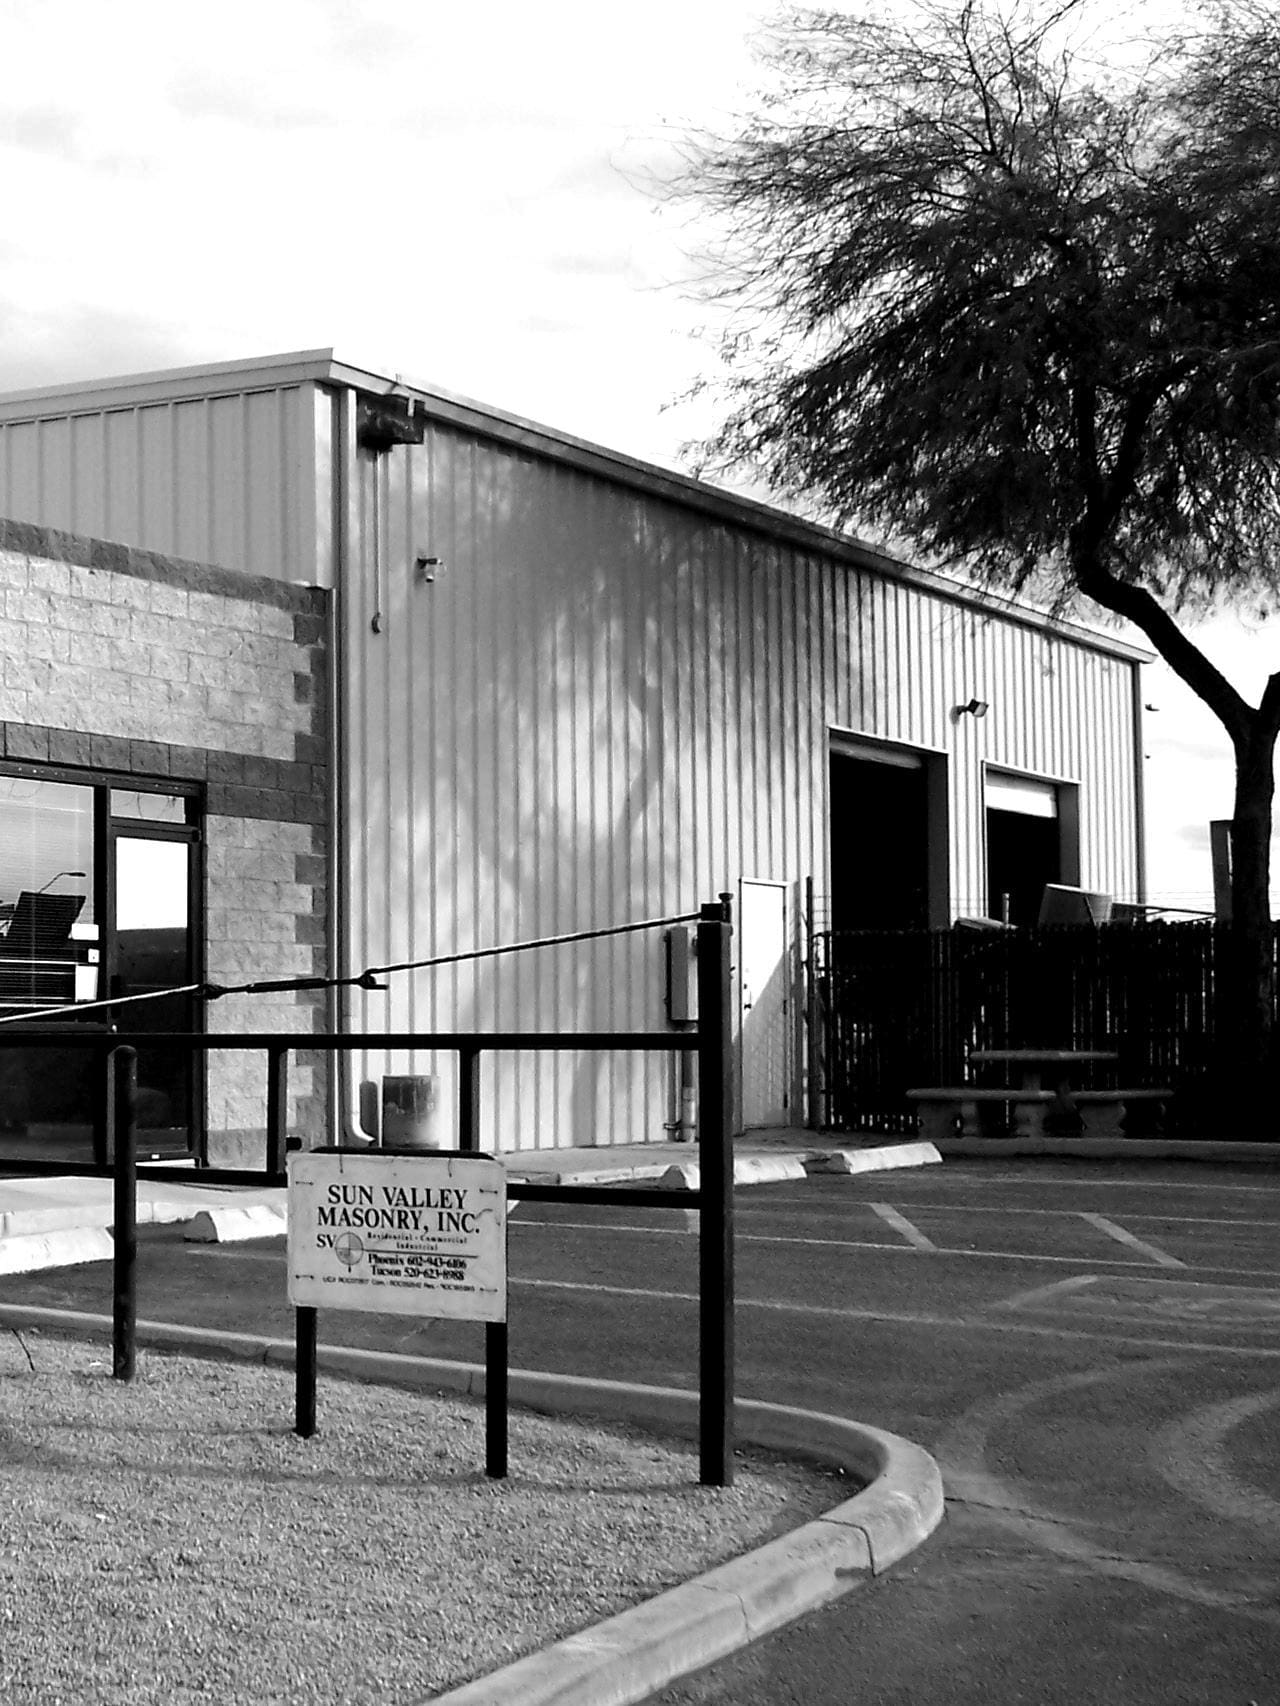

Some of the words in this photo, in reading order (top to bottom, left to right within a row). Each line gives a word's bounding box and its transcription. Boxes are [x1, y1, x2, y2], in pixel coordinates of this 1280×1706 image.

[328, 1184, 374, 1205] SUN
[383, 1187, 468, 1209] VALLEY
[317, 1207, 429, 1233] MASONRY,
[438, 1212, 480, 1234] INC.
[368, 1254, 404, 1266] Phoenix
[371, 1266, 402, 1277] Tucson
